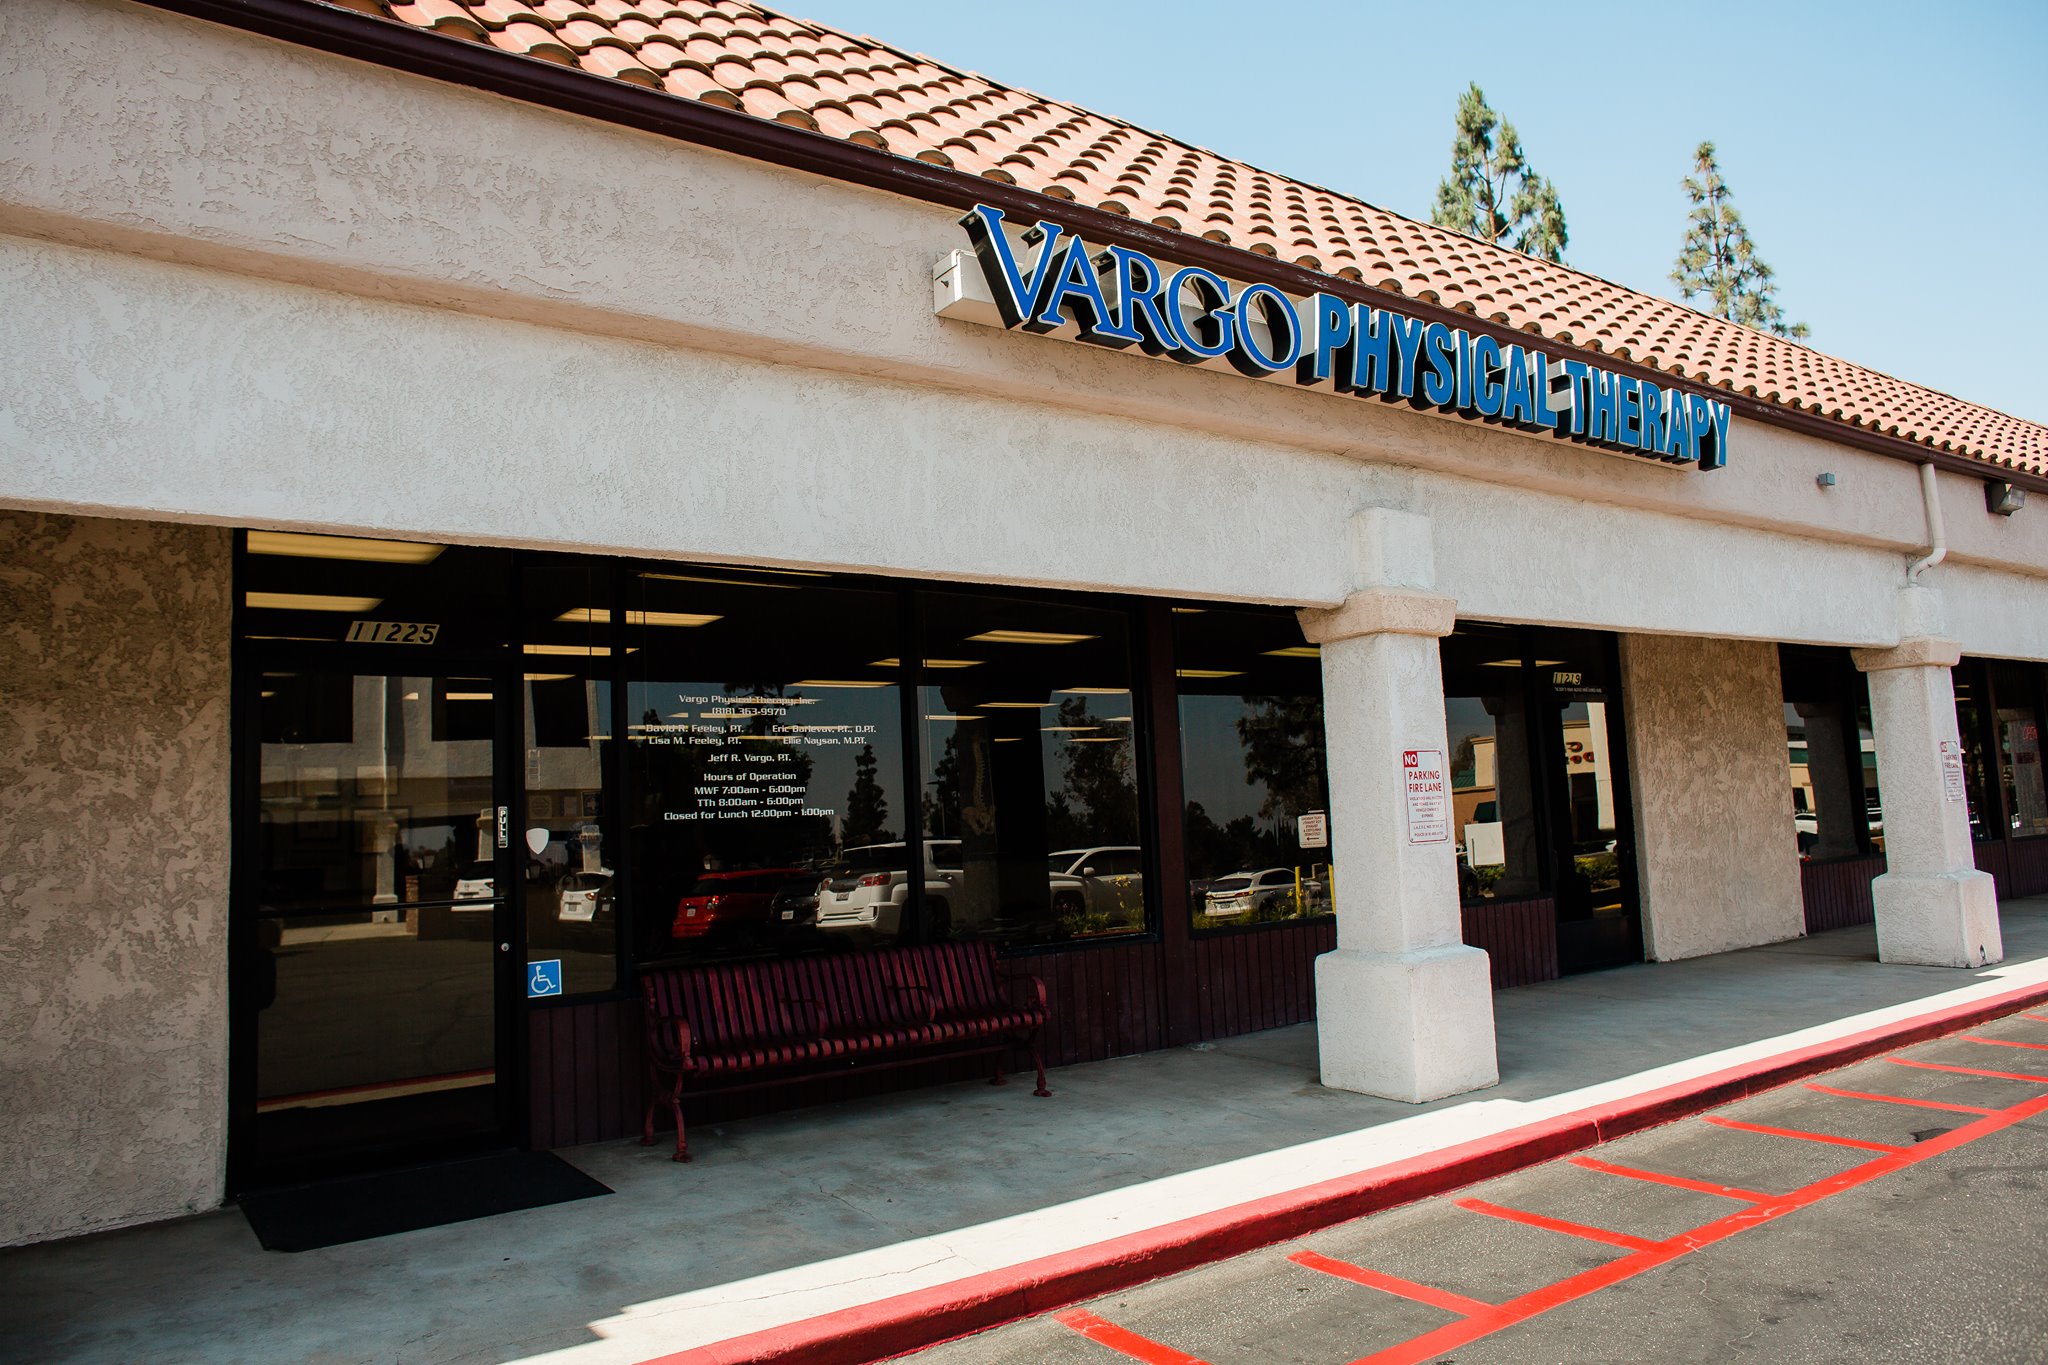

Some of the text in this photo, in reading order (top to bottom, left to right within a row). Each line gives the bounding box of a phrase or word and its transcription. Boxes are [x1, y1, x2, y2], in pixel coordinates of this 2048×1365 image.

[971, 203, 1732, 468] VARGO PHYSICAL THERAPY
[352, 622, 437, 644] 11225
[1555, 673, 1580, 685] 11219
[679, 694, 815, 706] Vargo Physical Therapy, Inc.
[712, 707, 787, 716] (818) 363-9970
[646, 724, 744, 734] David R. Feeley, P.T.
[772, 725, 790, 733] Eric
[855, 725, 877, 733] D.P.T.
[649, 736, 742, 746] Lisa M. Feeley, P.T.
[783, 736, 802, 745] Ellie
[843, 736, 867, 745] M.P.T.
[707, 753, 792, 763] Jeff R. Vargo, P.T.
[1404, 753, 1417, 766] NO
[704, 772, 797, 782] Hours of Operation
[1408, 770, 1440, 780] PARKING
[694, 786, 720, 795] MWF
[722, 786, 759, 795] 7:00am
[769, 785, 806, 795] 6:00pm
[1408, 782, 1442, 793] FIRE LANE
[697, 798, 716, 807] TTh
[718, 798, 757, 807] 8:00am
[766, 797, 804, 807] 6:00pm
[664, 811, 698, 820] Closed
[700, 810, 716, 820] for
[718, 809, 748, 819] Lunch
[750, 809, 792, 818] 12:00pm
[801, 808, 834, 817] 1:00pm
